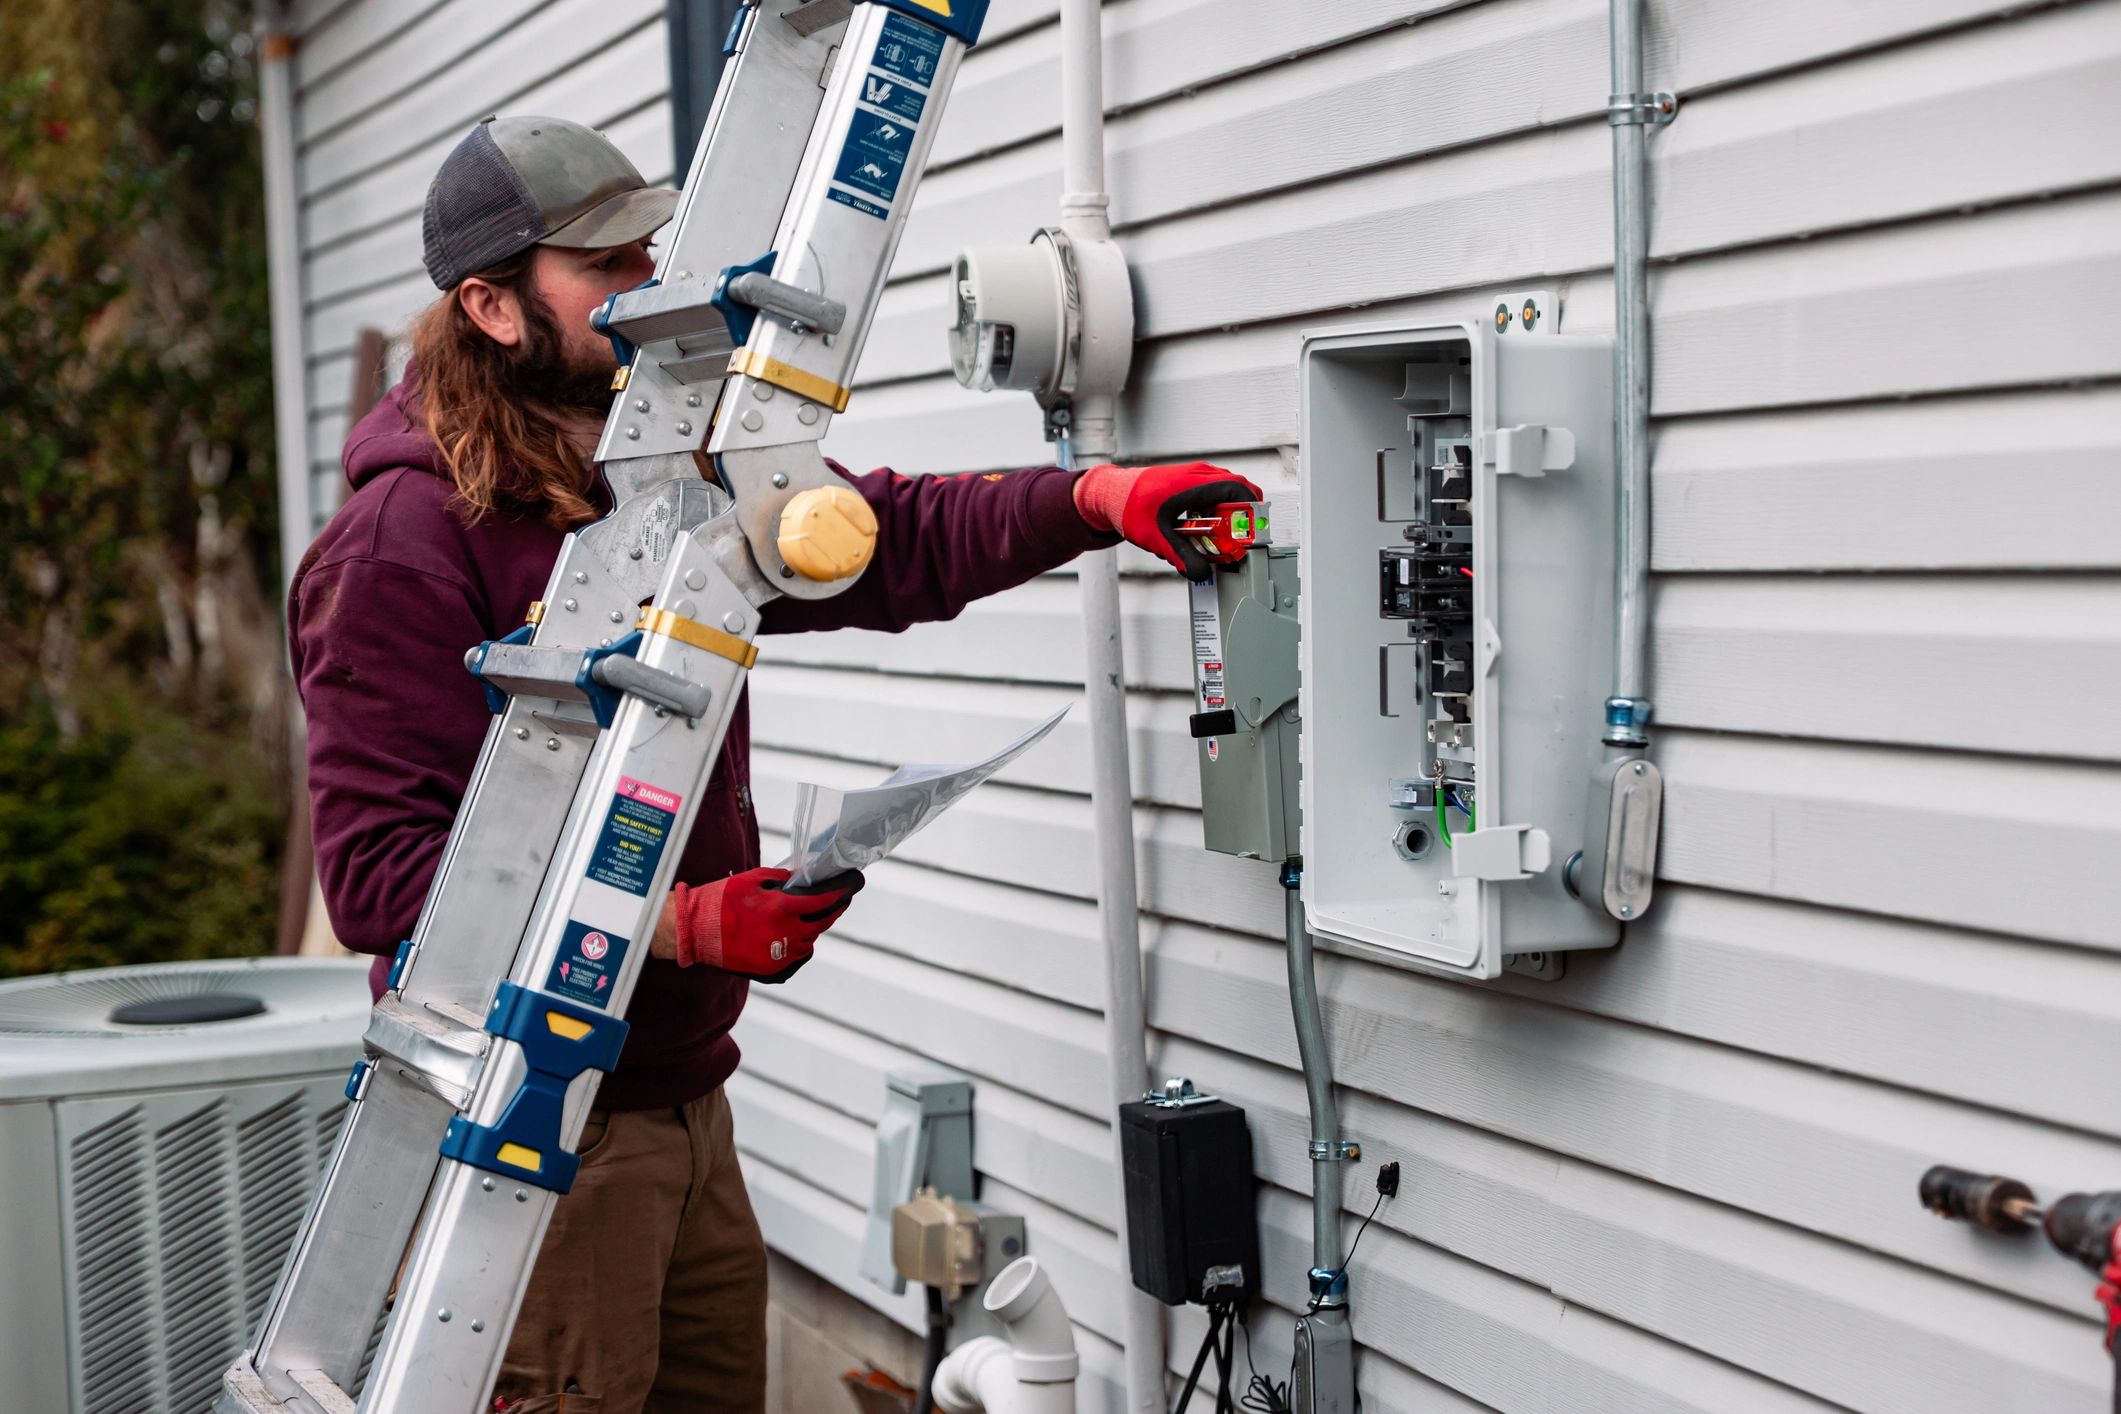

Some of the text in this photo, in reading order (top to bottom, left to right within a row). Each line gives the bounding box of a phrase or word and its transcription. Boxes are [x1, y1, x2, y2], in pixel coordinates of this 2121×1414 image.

[638, 788, 674, 807] DANGER
[613, 813, 629, 824] THINK
[628, 819, 647, 830] SAFETY
[619, 839, 629, 848] DID
